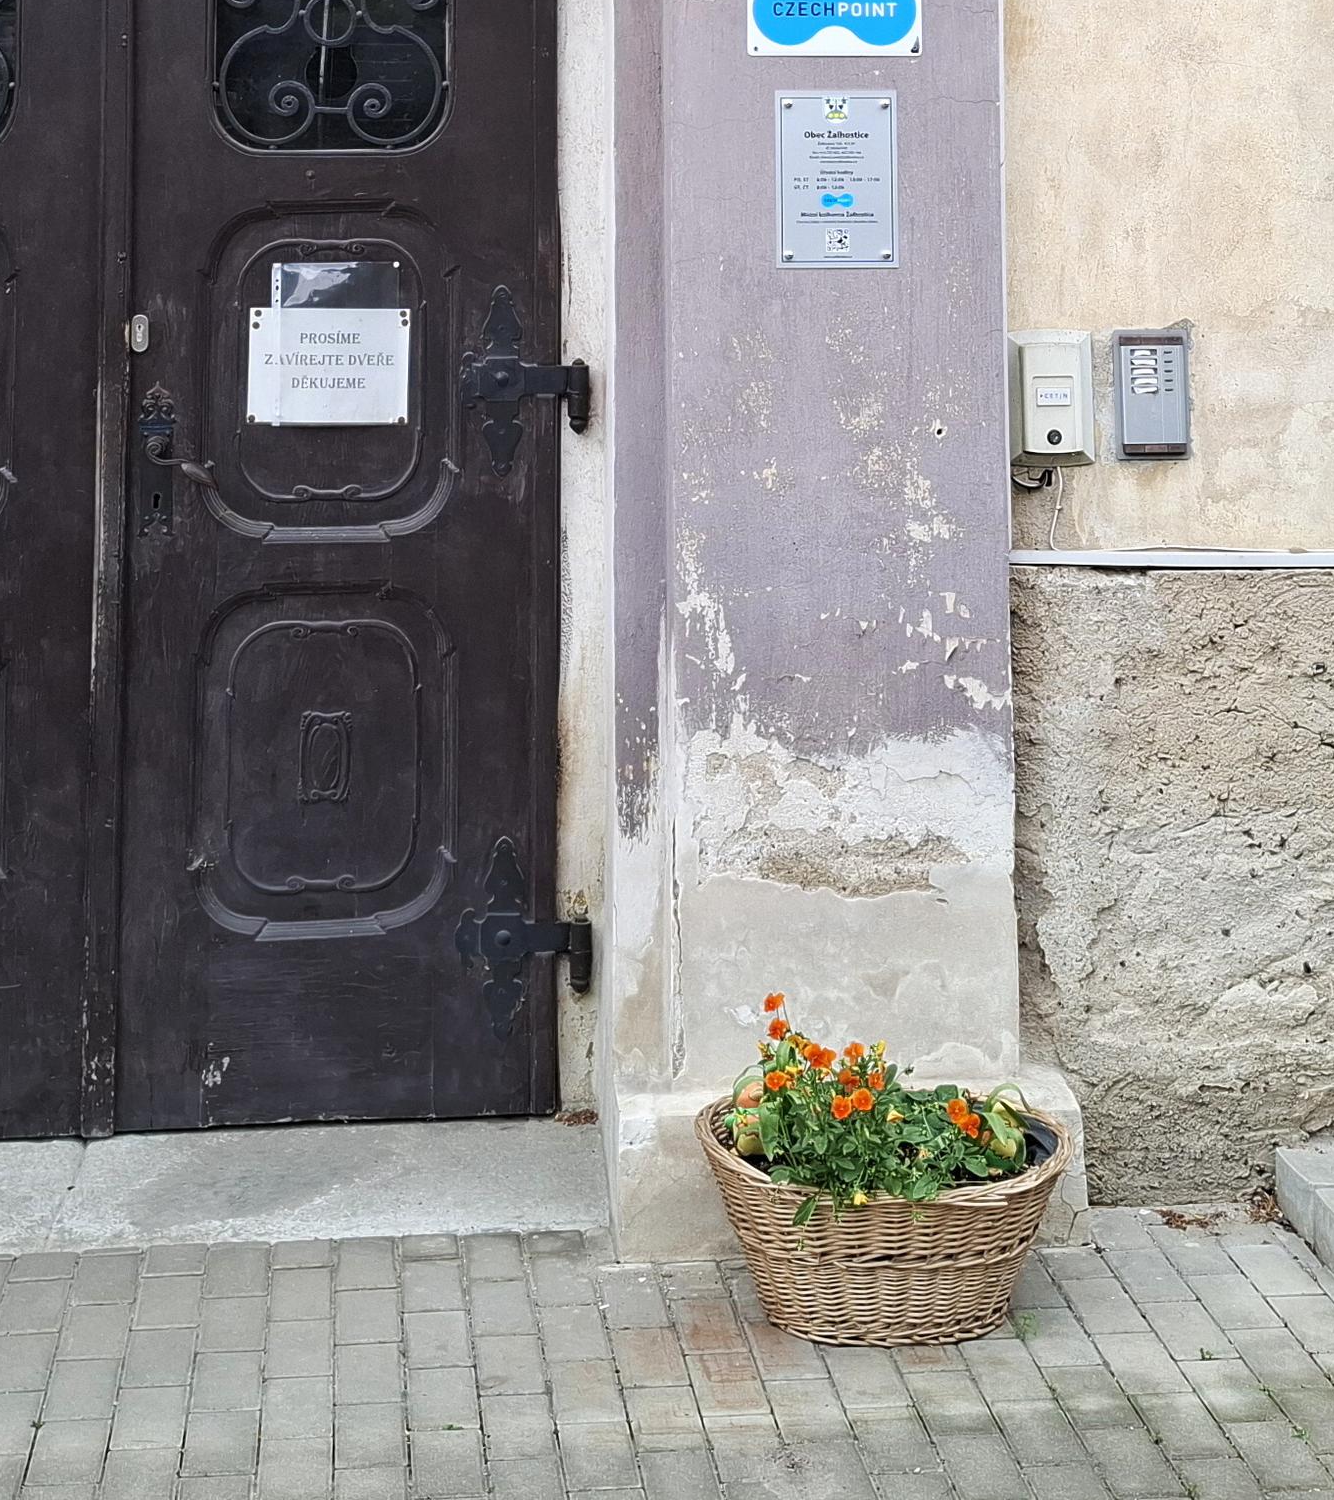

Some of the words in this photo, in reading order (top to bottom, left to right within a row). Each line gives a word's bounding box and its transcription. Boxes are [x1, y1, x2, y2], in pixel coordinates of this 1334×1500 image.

[804, 131, 825, 139] Obec
[827, 130, 869, 139] Žalhostice
[299, 330, 362, 345] PROSÍME
[348, 352, 395, 366] DVEŘE
[291, 375, 367, 390] DĚKUJEME
